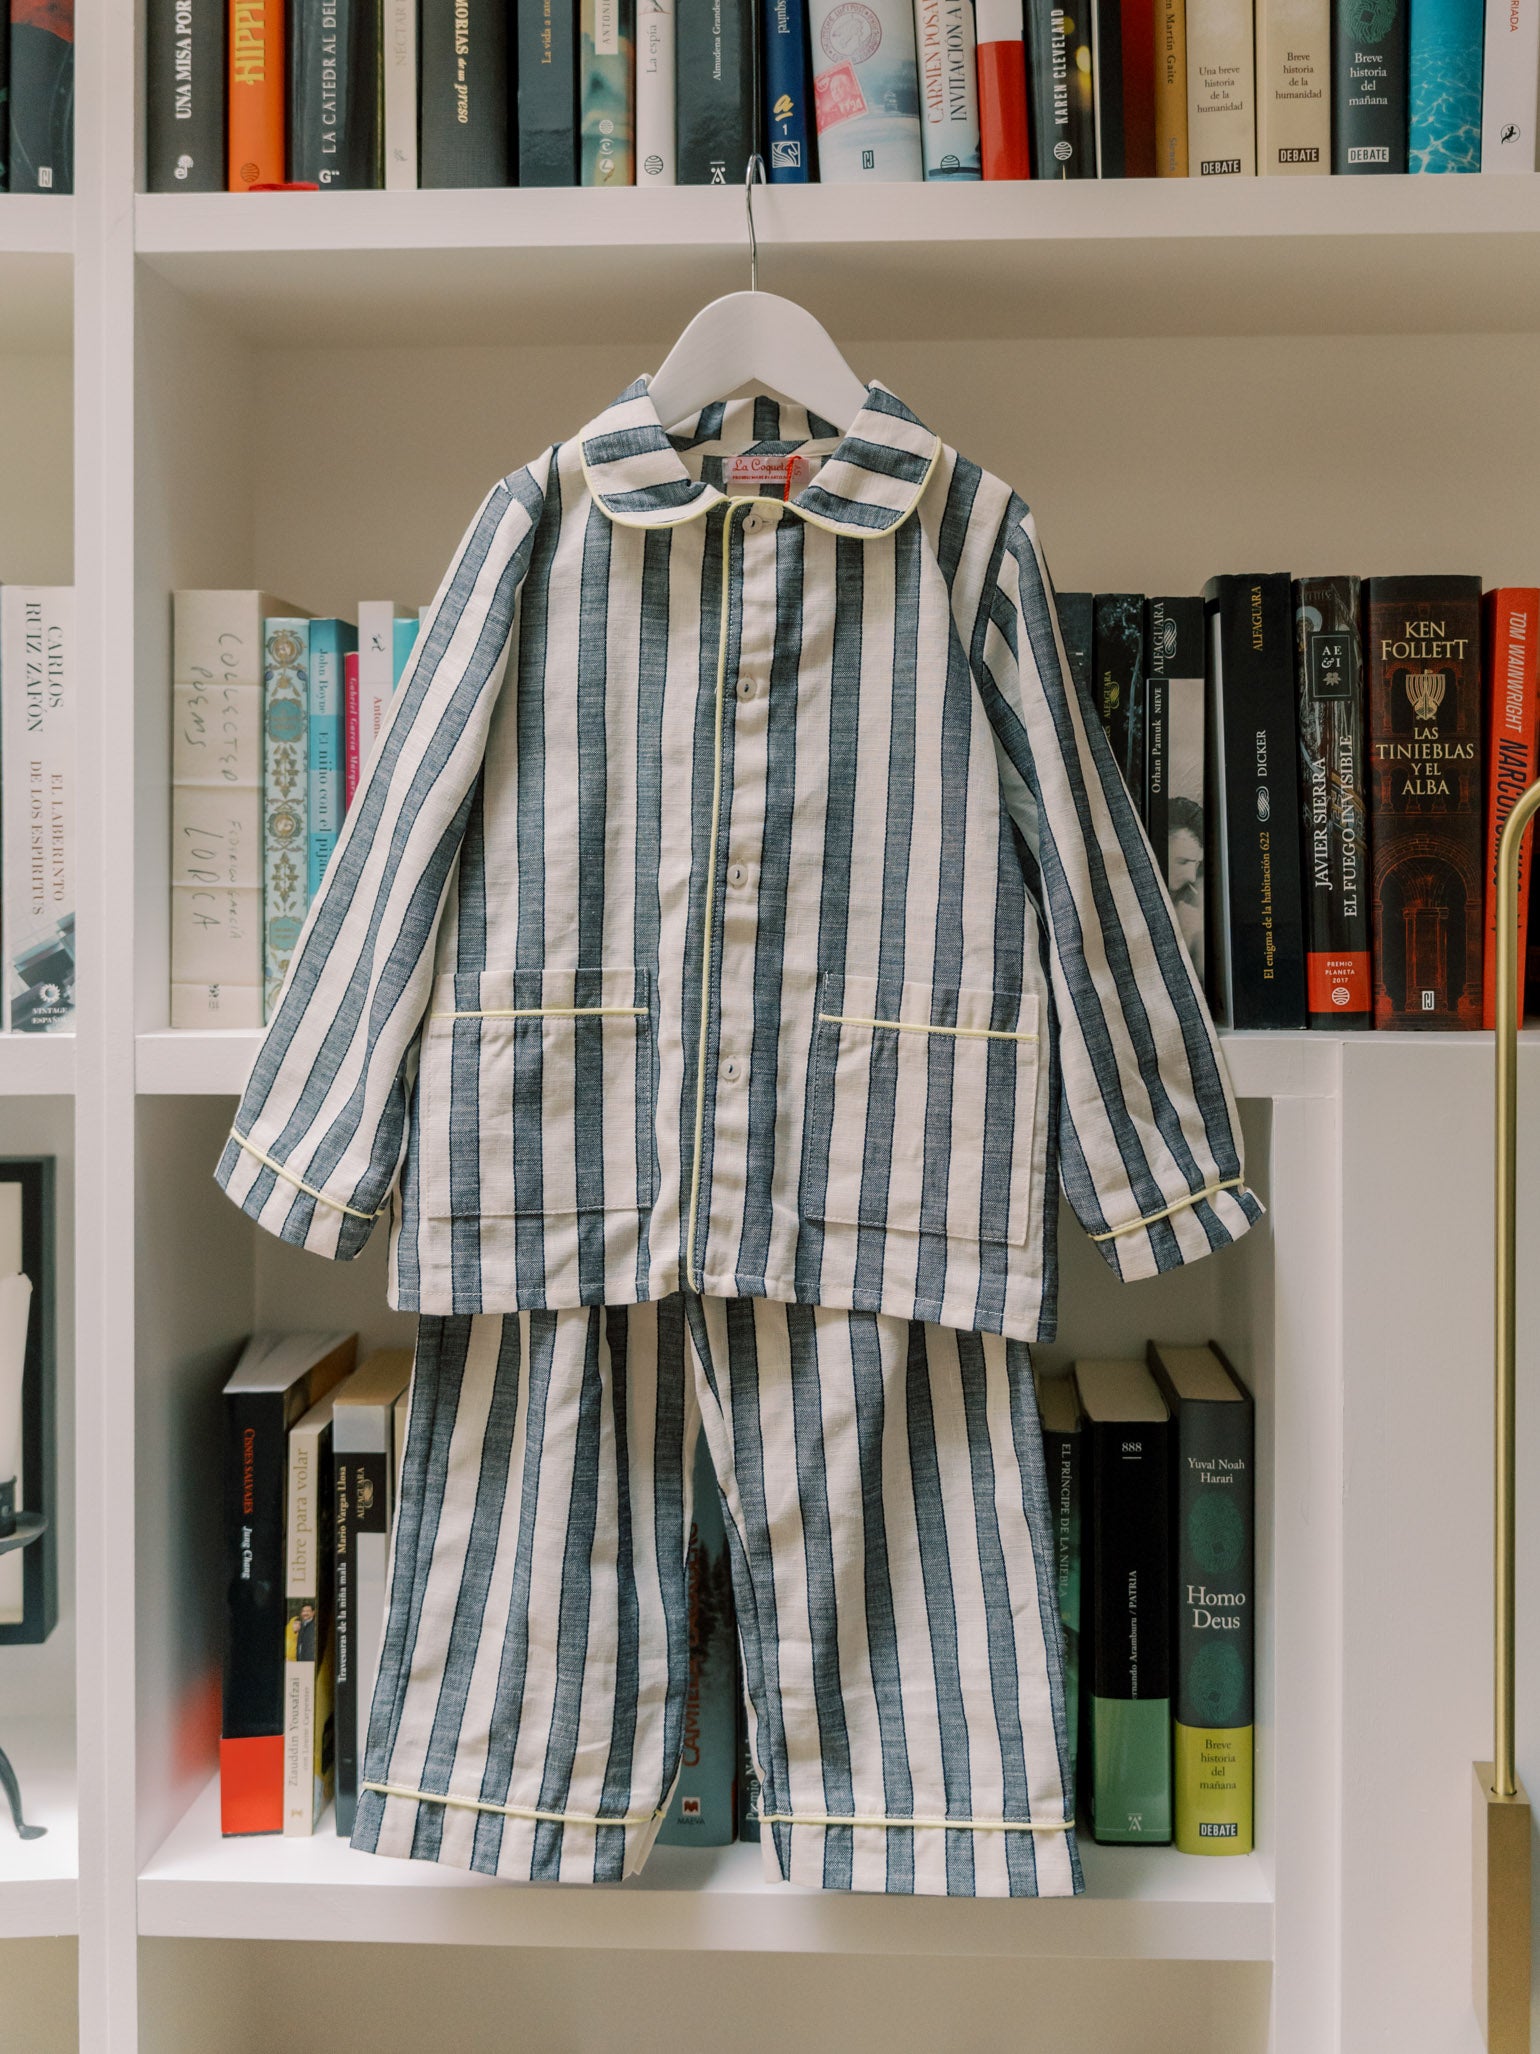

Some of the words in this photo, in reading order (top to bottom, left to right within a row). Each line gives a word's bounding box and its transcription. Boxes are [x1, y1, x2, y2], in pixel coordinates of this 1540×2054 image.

[175, 0, 192, 34] POR
[322, 0, 337, 27] DEL
[712, 0, 722, 34] Grandes
[921, 0, 941, 46] POSA
[946, 7, 963, 19] A
[541, 28, 552, 49] vida
[1050, 8, 1067, 80] CLEVELAND
[1165, 14, 1176, 51] Martín
[175, 39, 192, 81] MISA
[541, 51, 552, 64] La
[646, 59, 658, 73] La
[712, 36, 722, 81] Almudena
[1166, 54, 1177, 84] Gaite
[1287, 52, 1311, 62] Breve
[1354, 52, 1384, 64] Breve
[322, 34, 337, 124] CATEDRAL
[946, 23, 968, 122] INVITACIÓN
[1199, 66, 1217, 76] Una
[1218, 65, 1241, 75] breve
[1283, 64, 1315, 75] historia
[1288, 77, 1299, 87] de
[1300, 76, 1309, 86] la
[1349, 66, 1388, 78] historia
[924, 50, 945, 124] CARMEN
[1204, 77, 1235, 88] historia
[1275, 89, 1323, 100] humanidad
[1360, 79, 1377, 92] del
[175, 84, 192, 119] UNA
[454, 83, 469, 124] preso
[1053, 84, 1069, 125] KAREN
[1209, 90, 1221, 100] de
[1221, 90, 1230, 99] la
[1348, 94, 1389, 106] mañana
[1196, 102, 1244, 114] humanidad
[322, 131, 337, 154] LA
[1279, 149, 1318, 162] DEBATE
[1350, 148, 1388, 162] DEBATE
[1202, 161, 1240, 175] DEBATE
[731, 458, 749, 472] La
[25, 602, 42, 654] RUIZ
[1250, 585, 1264, 651] ALFAGUARA
[1405, 621, 1446, 639] KEN
[1508, 611, 1528, 641] TOM
[1153, 602, 1165, 675] ALFAGUARA
[1322, 645, 1331, 656] A
[1334, 645, 1342, 656] E
[1380, 639, 1469, 661] FOLLETT
[48, 625, 64, 709] CARLOS
[318, 648, 329, 680] John
[26, 662, 47, 732] ZAFÓN
[317, 683, 329, 714] Boyne
[1103, 670, 1113, 718] ALFAGUARA
[1505, 643, 1527, 733] WAINWRIGHT
[217, 632, 243, 782] COLLECTED
[1154, 687, 1162, 714] NIEVE
[319, 731, 329, 745] El
[1151, 719, 1162, 755] Pamuk
[1414, 727, 1439, 740] LAS
[1256, 729, 1268, 777] DICKER
[1375, 743, 1475, 760] TINIEBLAS
[30, 760, 42, 782] DE
[318, 750, 333, 785] niño
[1151, 759, 1162, 793] Orhan
[1339, 734, 1355, 824] INVISIBLE
[1411, 762, 1421, 776] Y
[1425, 762, 1442, 776] EL
[51, 774, 63, 792] EL
[1312, 757, 1328, 825] SIERRA
[1402, 779, 1450, 795] ALBA
[30, 789, 43, 820] LOS
[318, 789, 329, 815] con
[318, 819, 332, 832] el
[51, 801, 65, 902] LABERINTO
[1259, 831, 1270, 851] 622
[1313, 827, 1333, 891] JAVIER
[1341, 827, 1357, 892] FUEGO
[183, 826, 225, 931] LORCA
[1260, 853, 1272, 904] habitación
[1261, 905, 1272, 915] la
[1343, 894, 1358, 917] EL
[1262, 916, 1273, 929] de
[1263, 931, 1277, 967] enigma
[1263, 968, 1275, 979] El
[1061, 1443, 1071, 1458] EL
[1121, 1442, 1143, 1452] 888
[293, 1448, 309, 1491] volar
[1187, 1457, 1216, 1470] Yuval
[1218, 1458, 1245, 1470] Noah
[337, 1465, 347, 1491] Llosa
[1060, 1460, 1073, 1514] PRÍNCIPE
[1200, 1472, 1234, 1484] Harari
[296, 1497, 312, 1533] para
[337, 1494, 349, 1524] Vargas
[240, 1525, 253, 1548] Jung
[1060, 1518, 1070, 1533] DE
[337, 1525, 347, 1554] Mario
[1060, 1537, 1070, 1552] LA
[240, 1550, 253, 1579] Chang
[292, 1538, 307, 1583] Libre
[337, 1562, 347, 1585] mala
[1059, 1554, 1069, 1597] NIEBLA
[337, 1586, 347, 1608] niña
[1128, 1569, 1138, 1609] PATRIA
[1186, 1584, 1246, 1606] Homo
[336, 1610, 347, 1620] la
[336, 1620, 347, 1634] de
[1192, 1608, 1241, 1629] Deus
[1128, 1617, 1138, 1662] Aramburu
[336, 1635, 347, 1684] Travesuras
[1128, 1664, 1138, 1699] rnando
[289, 1677, 300, 1732] Yousafzai
[1205, 1738, 1232, 1750] Breve
[288, 1736, 298, 1787] Ziauddin
[1200, 1752, 1236, 1764] historia
[1211, 1766, 1226, 1777] del
[1199, 1780, 1237, 1791] mañana
[676, 1817, 706, 1825] MAEVA
[1200, 1824, 1237, 1837] DEBATE
